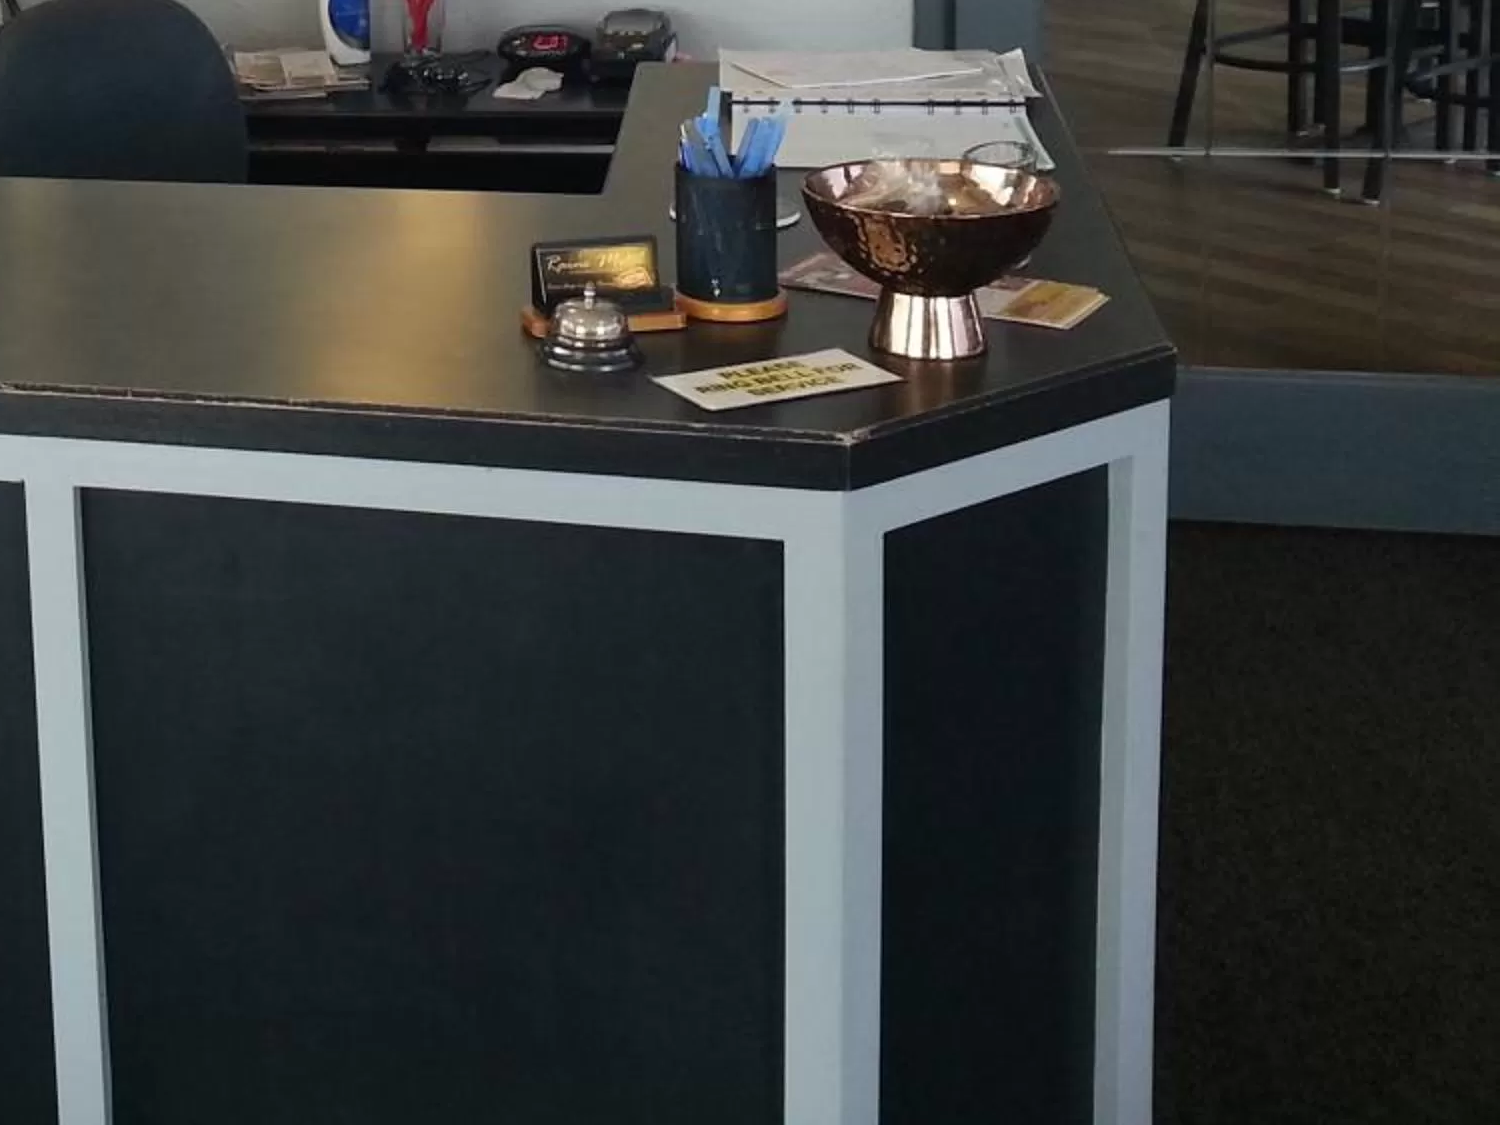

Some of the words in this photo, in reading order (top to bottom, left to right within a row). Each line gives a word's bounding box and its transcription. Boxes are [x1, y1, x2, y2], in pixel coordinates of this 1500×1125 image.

[717, 360, 805, 379] PLEASE
[695, 378, 752, 394] RING
[752, 370, 811, 386] BELL
[746, 375, 845, 396] SERVICE
